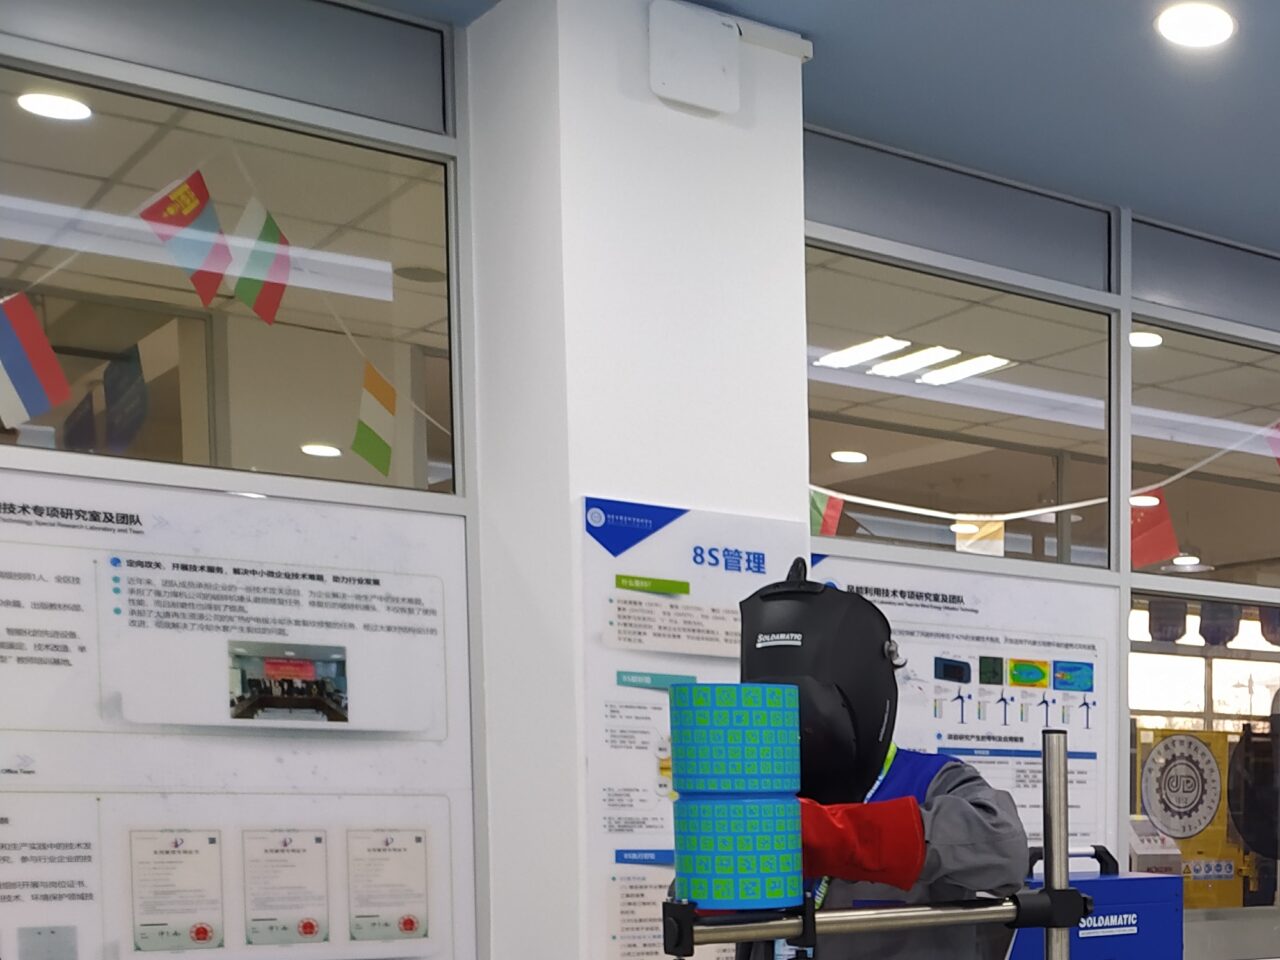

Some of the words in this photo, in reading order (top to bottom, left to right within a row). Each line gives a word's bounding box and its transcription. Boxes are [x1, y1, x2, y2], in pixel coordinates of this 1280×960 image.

[692, 545, 767, 575] 8S管理
[757, 633, 802, 643] SOLDAMATIC
[1079, 914, 1138, 928] SOLDAMATIC
